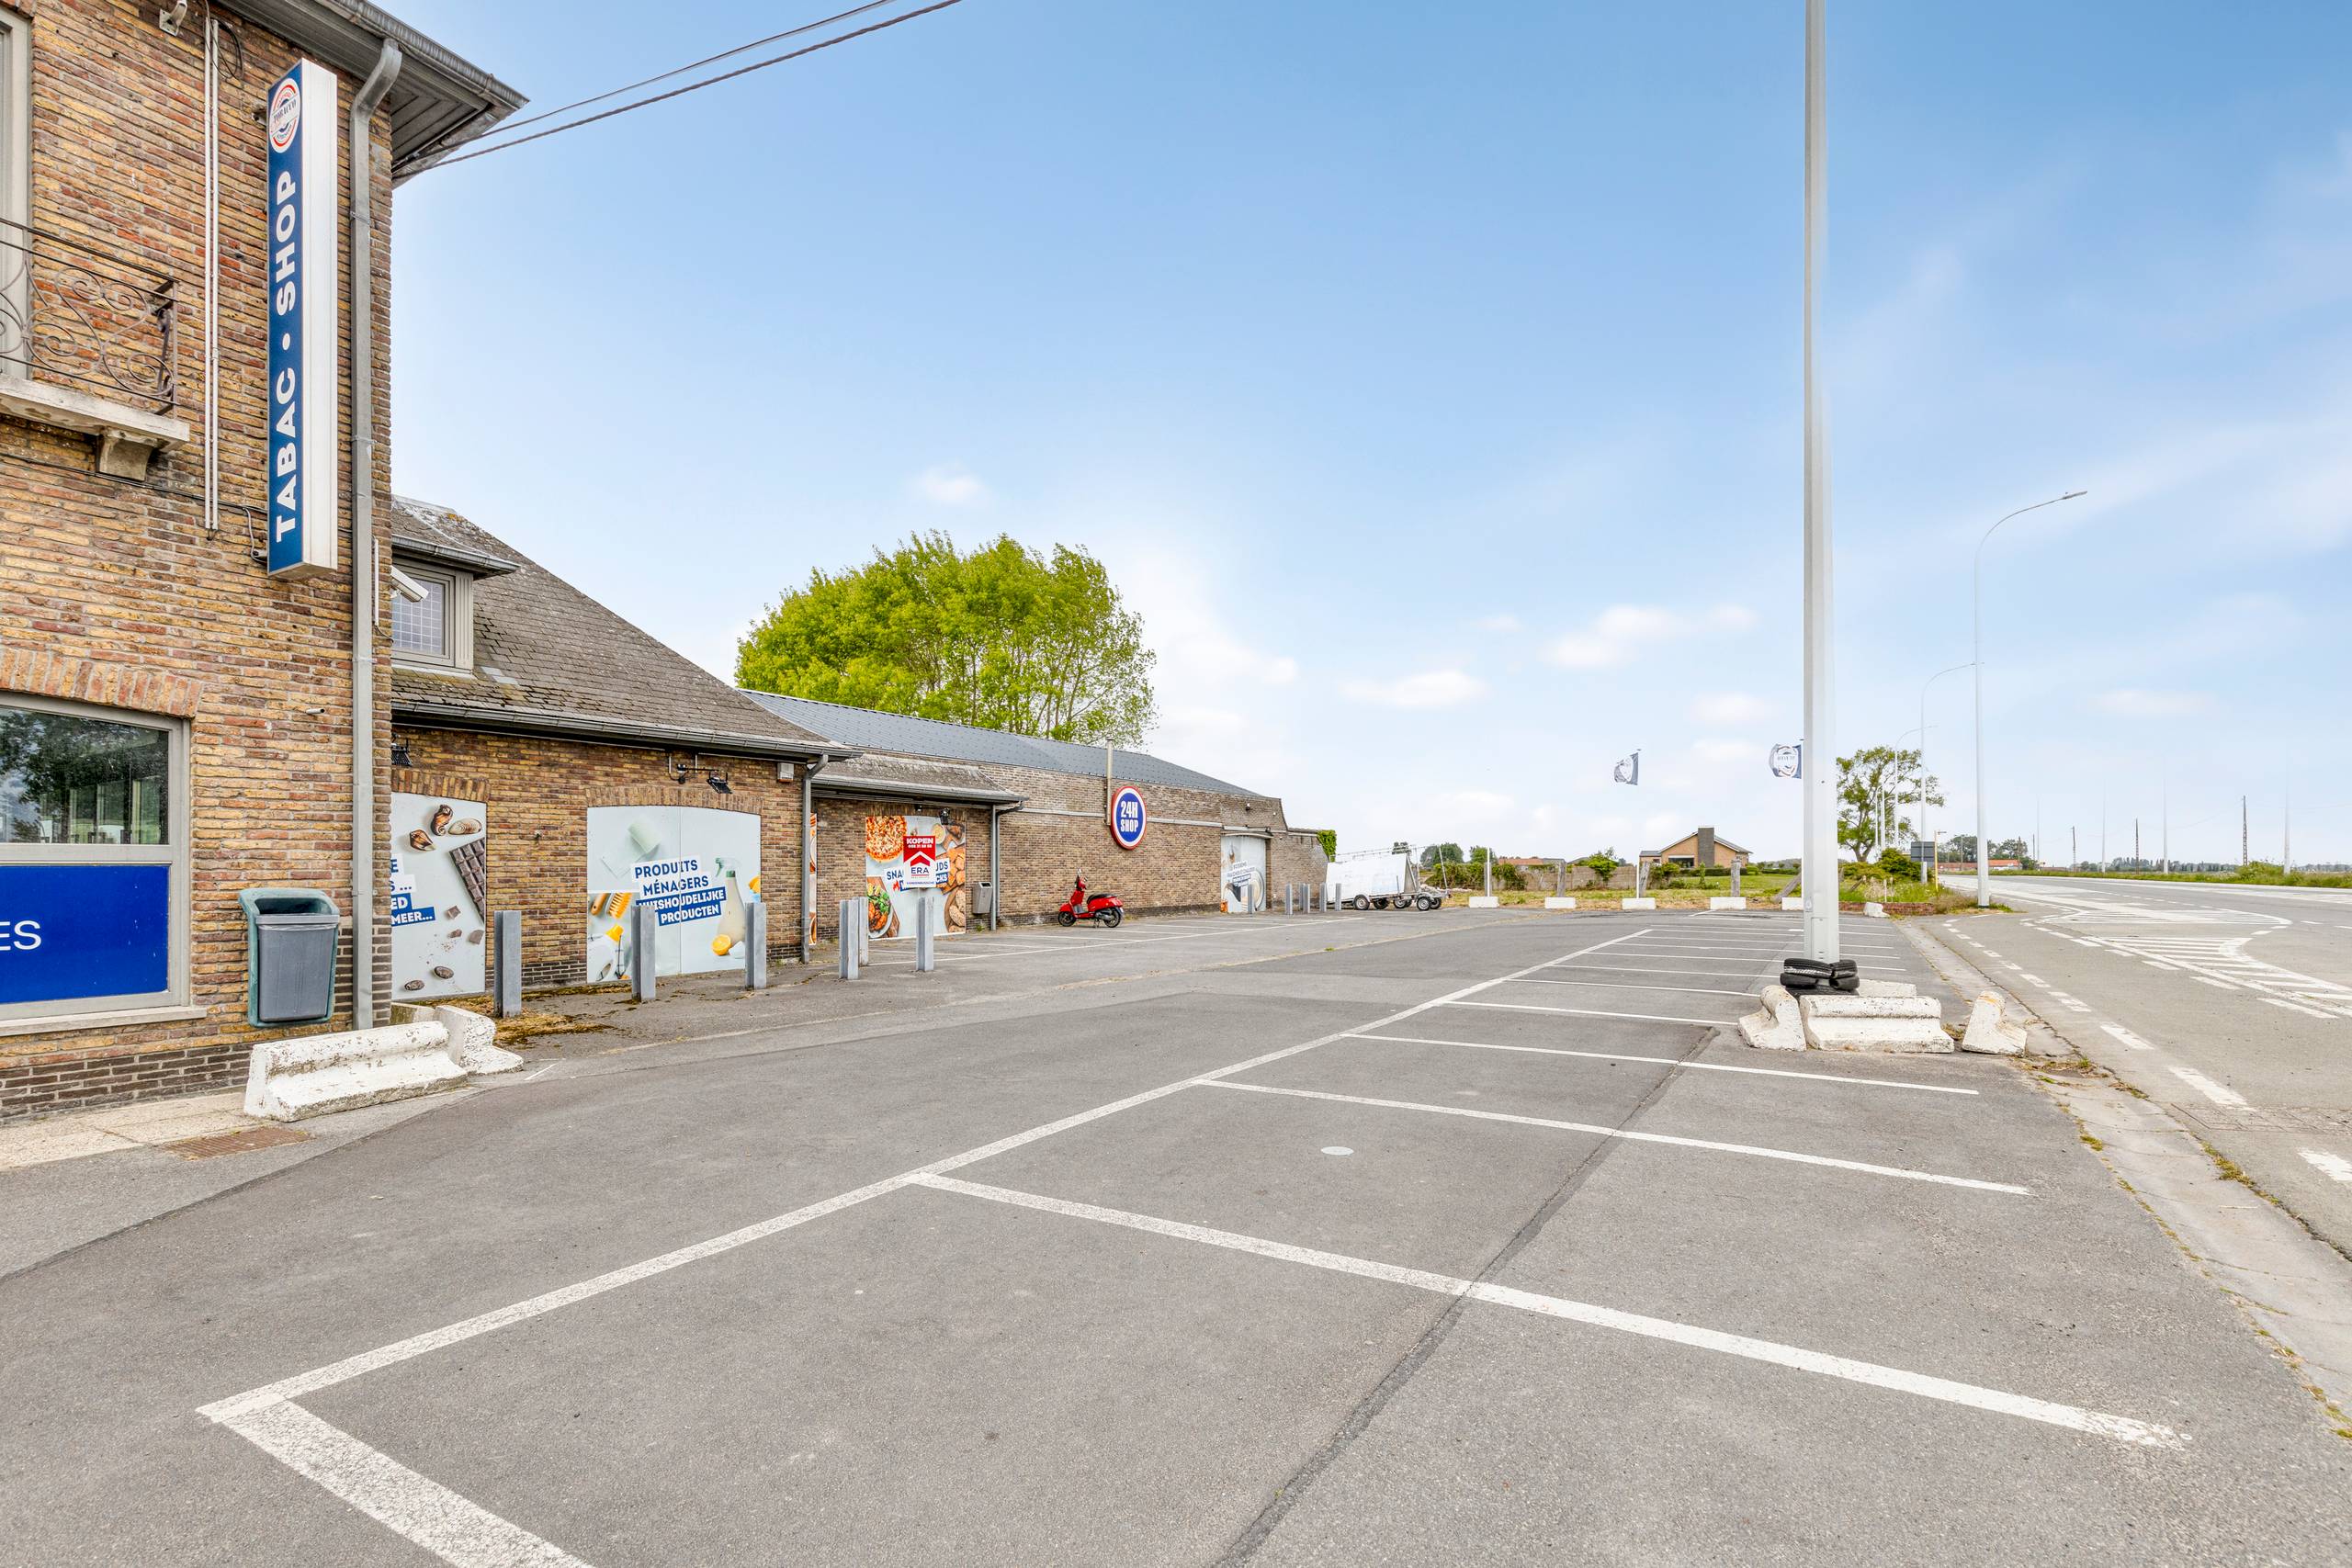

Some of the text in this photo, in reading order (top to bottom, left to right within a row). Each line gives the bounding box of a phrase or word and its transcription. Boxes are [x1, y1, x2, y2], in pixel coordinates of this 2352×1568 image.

[276, 171, 296, 543] TABAC SHOP
[1121, 800, 1138, 818] 24H
[1120, 818, 1138, 831] SHOP
[635, 859, 698, 879] PRODUITS
[887, 869, 904, 880] SNA
[643, 875, 709, 897] MÉNAGERS
[639, 889, 725, 910] ISHOUDELIJKE
[391, 911, 433, 925] MEER...
[661, 905, 719, 924] PRODUCTEN
